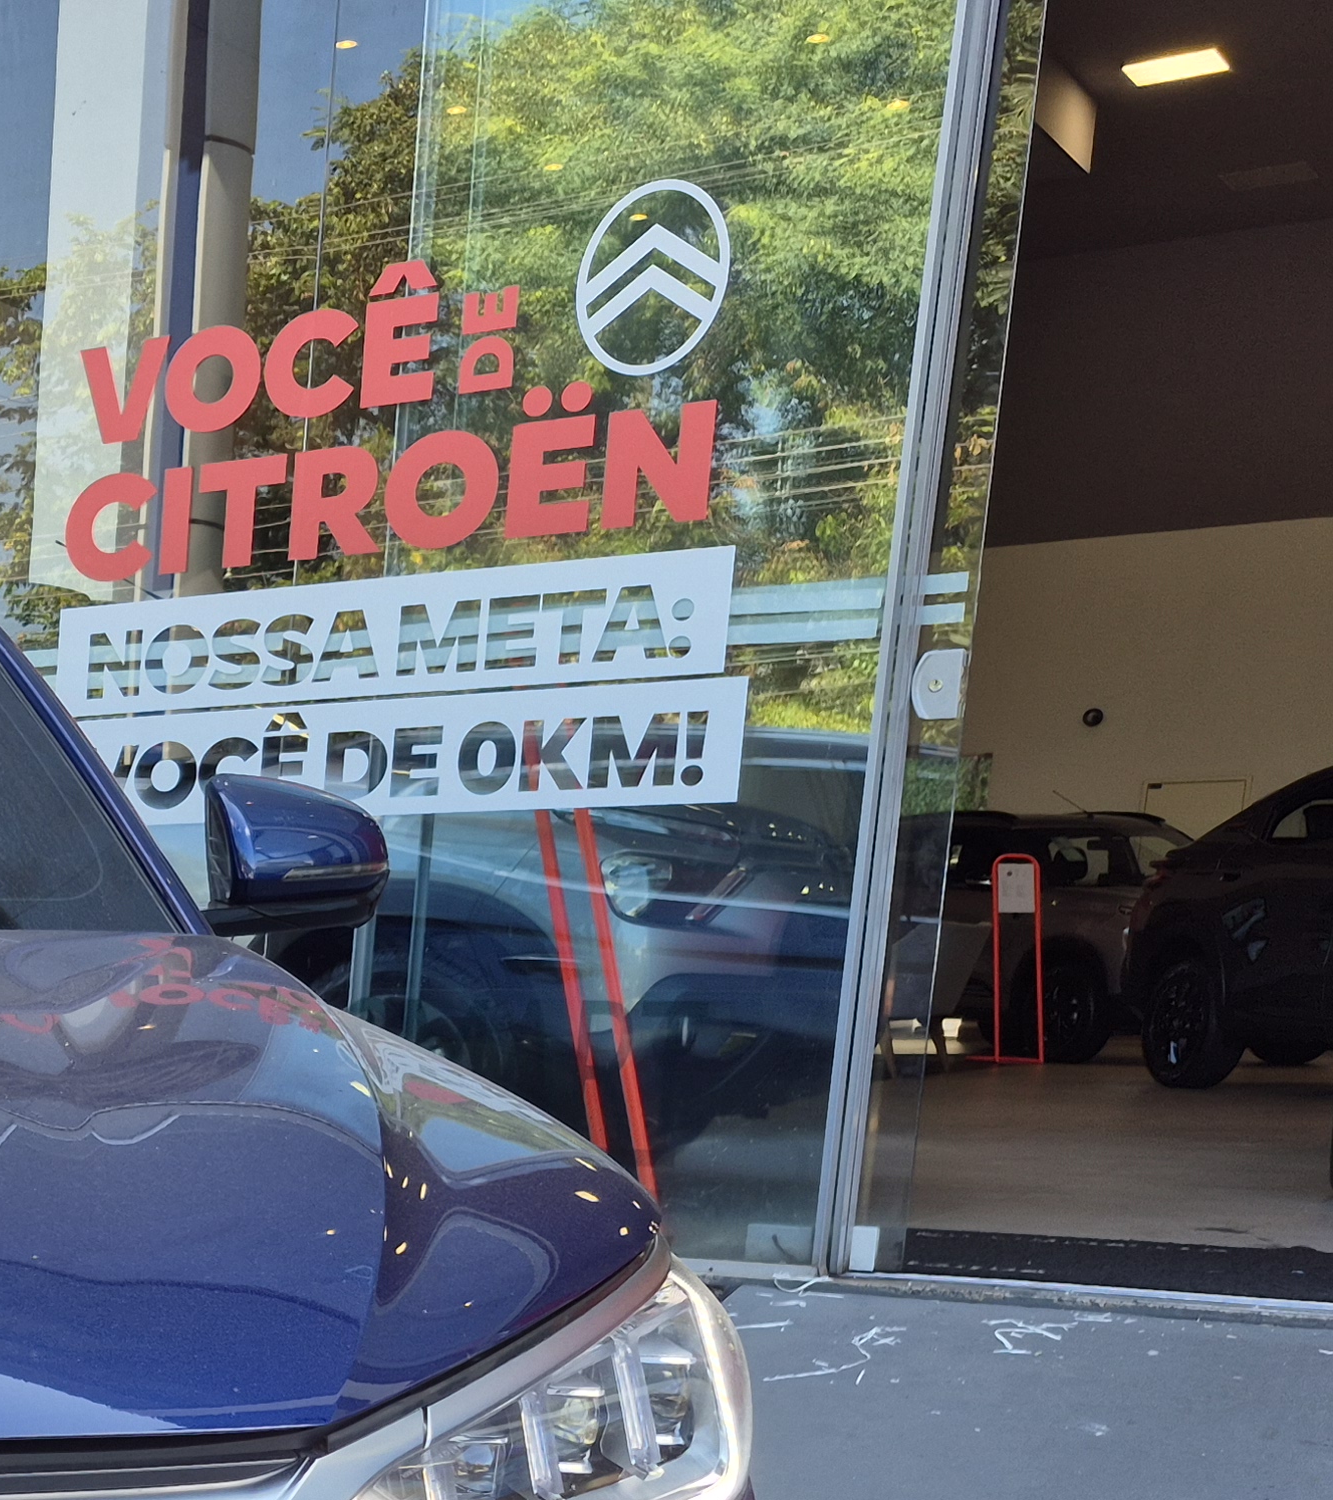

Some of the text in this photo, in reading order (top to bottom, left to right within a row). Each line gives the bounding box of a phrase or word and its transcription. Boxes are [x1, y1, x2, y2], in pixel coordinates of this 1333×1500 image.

[80, 259, 520, 444] VOCÊ DE
[65, 381, 718, 583] CITROËN
[87, 584, 695, 699] NOSSA META:
[324, 724, 444, 799] DE
